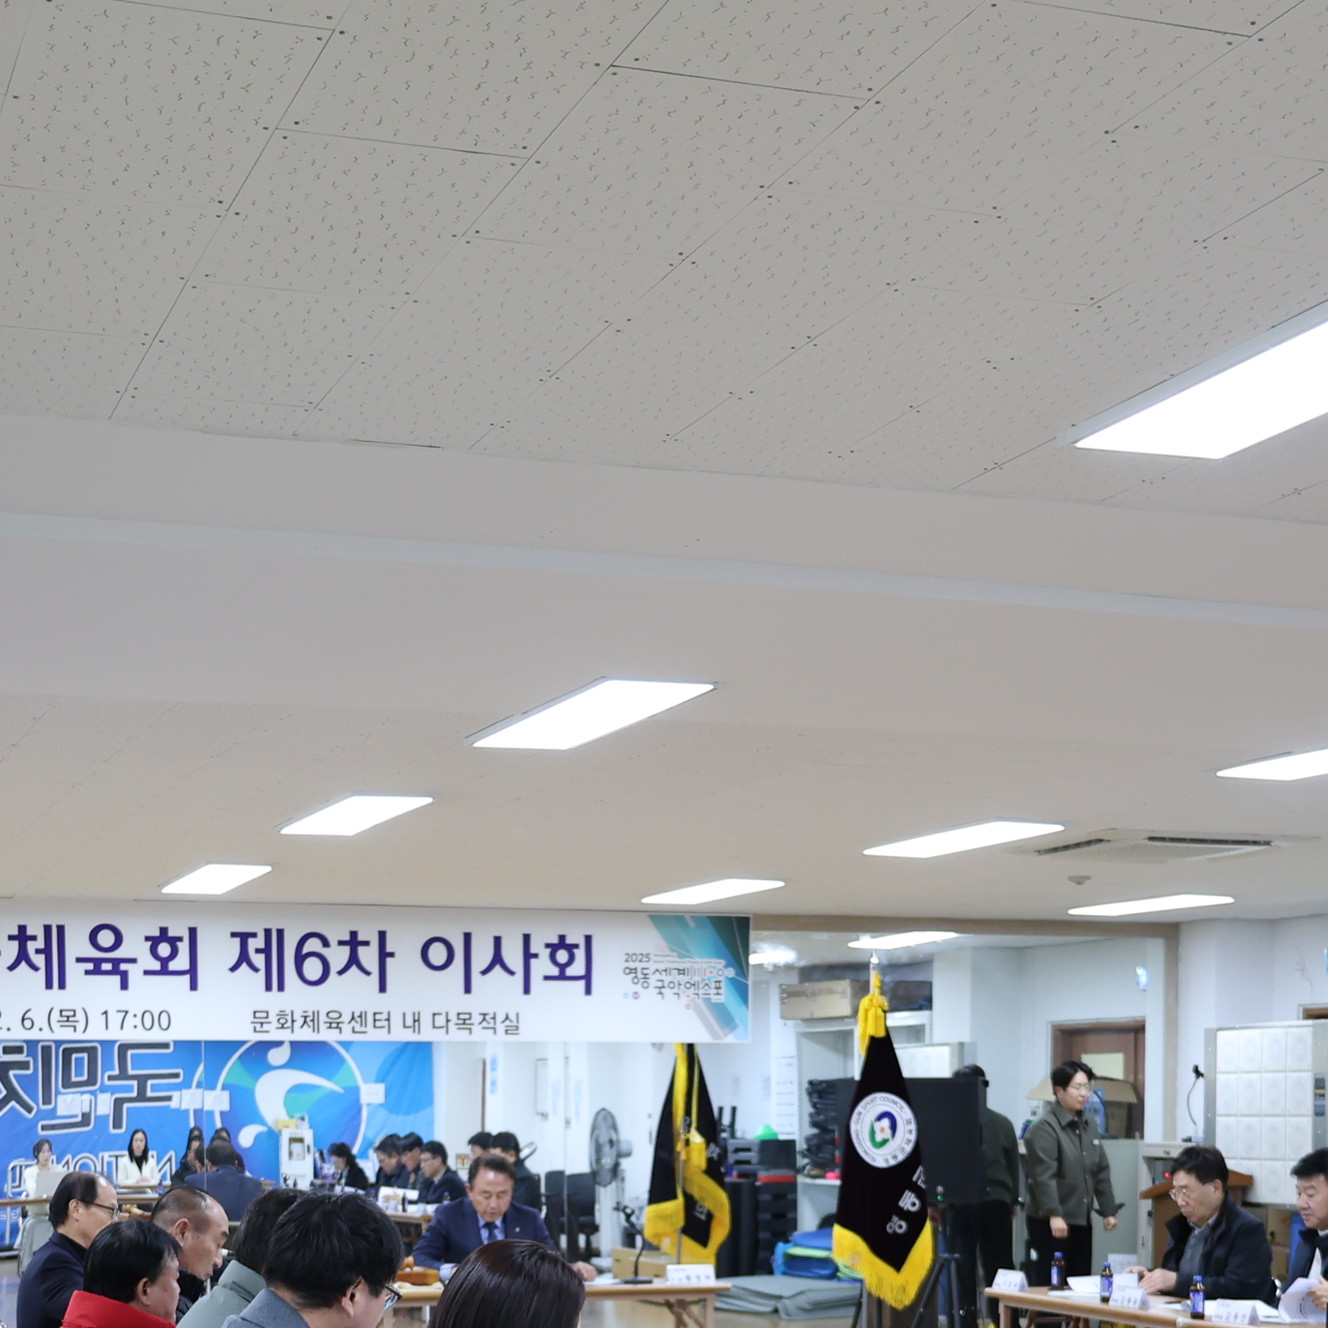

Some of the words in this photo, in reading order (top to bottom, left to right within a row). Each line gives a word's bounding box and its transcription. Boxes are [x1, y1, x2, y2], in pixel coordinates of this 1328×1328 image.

[228, 927, 396, 994] 제6차
[420, 930, 593, 996] 이사회
[624, 952, 651, 963] 2025
[100, 1010, 172, 1032] 17:00
[249, 1009, 392, 1036] 문화체육센터
[402, 1012, 423, 1036] 내
[431, 1010, 522, 1036] 다목적실
